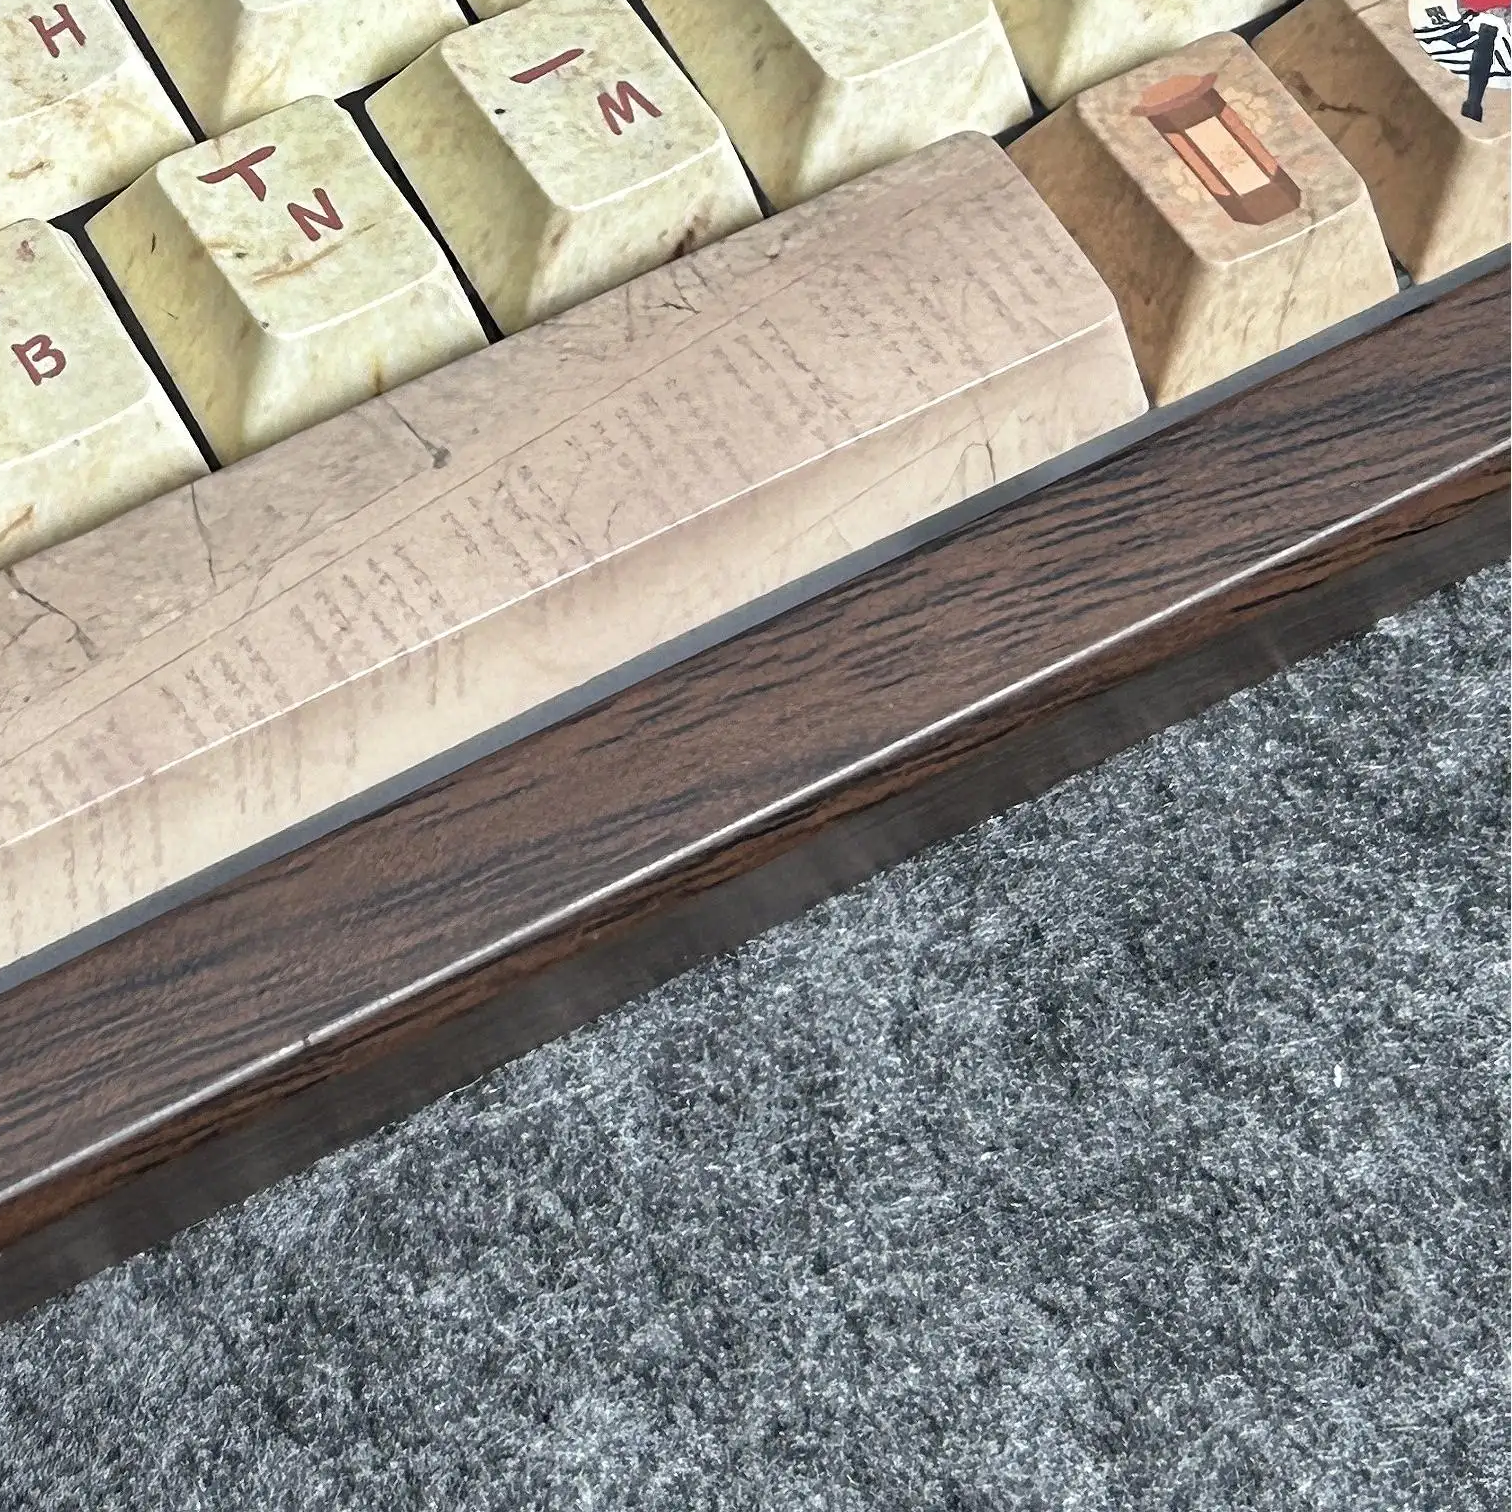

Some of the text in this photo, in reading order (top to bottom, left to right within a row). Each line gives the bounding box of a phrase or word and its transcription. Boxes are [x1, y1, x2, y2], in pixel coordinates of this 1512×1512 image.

[27, 4, 86, 58] H
[596, 80, 662, 136] M
[287, 188, 343, 243] N
[10, 334, 67, 386] B
